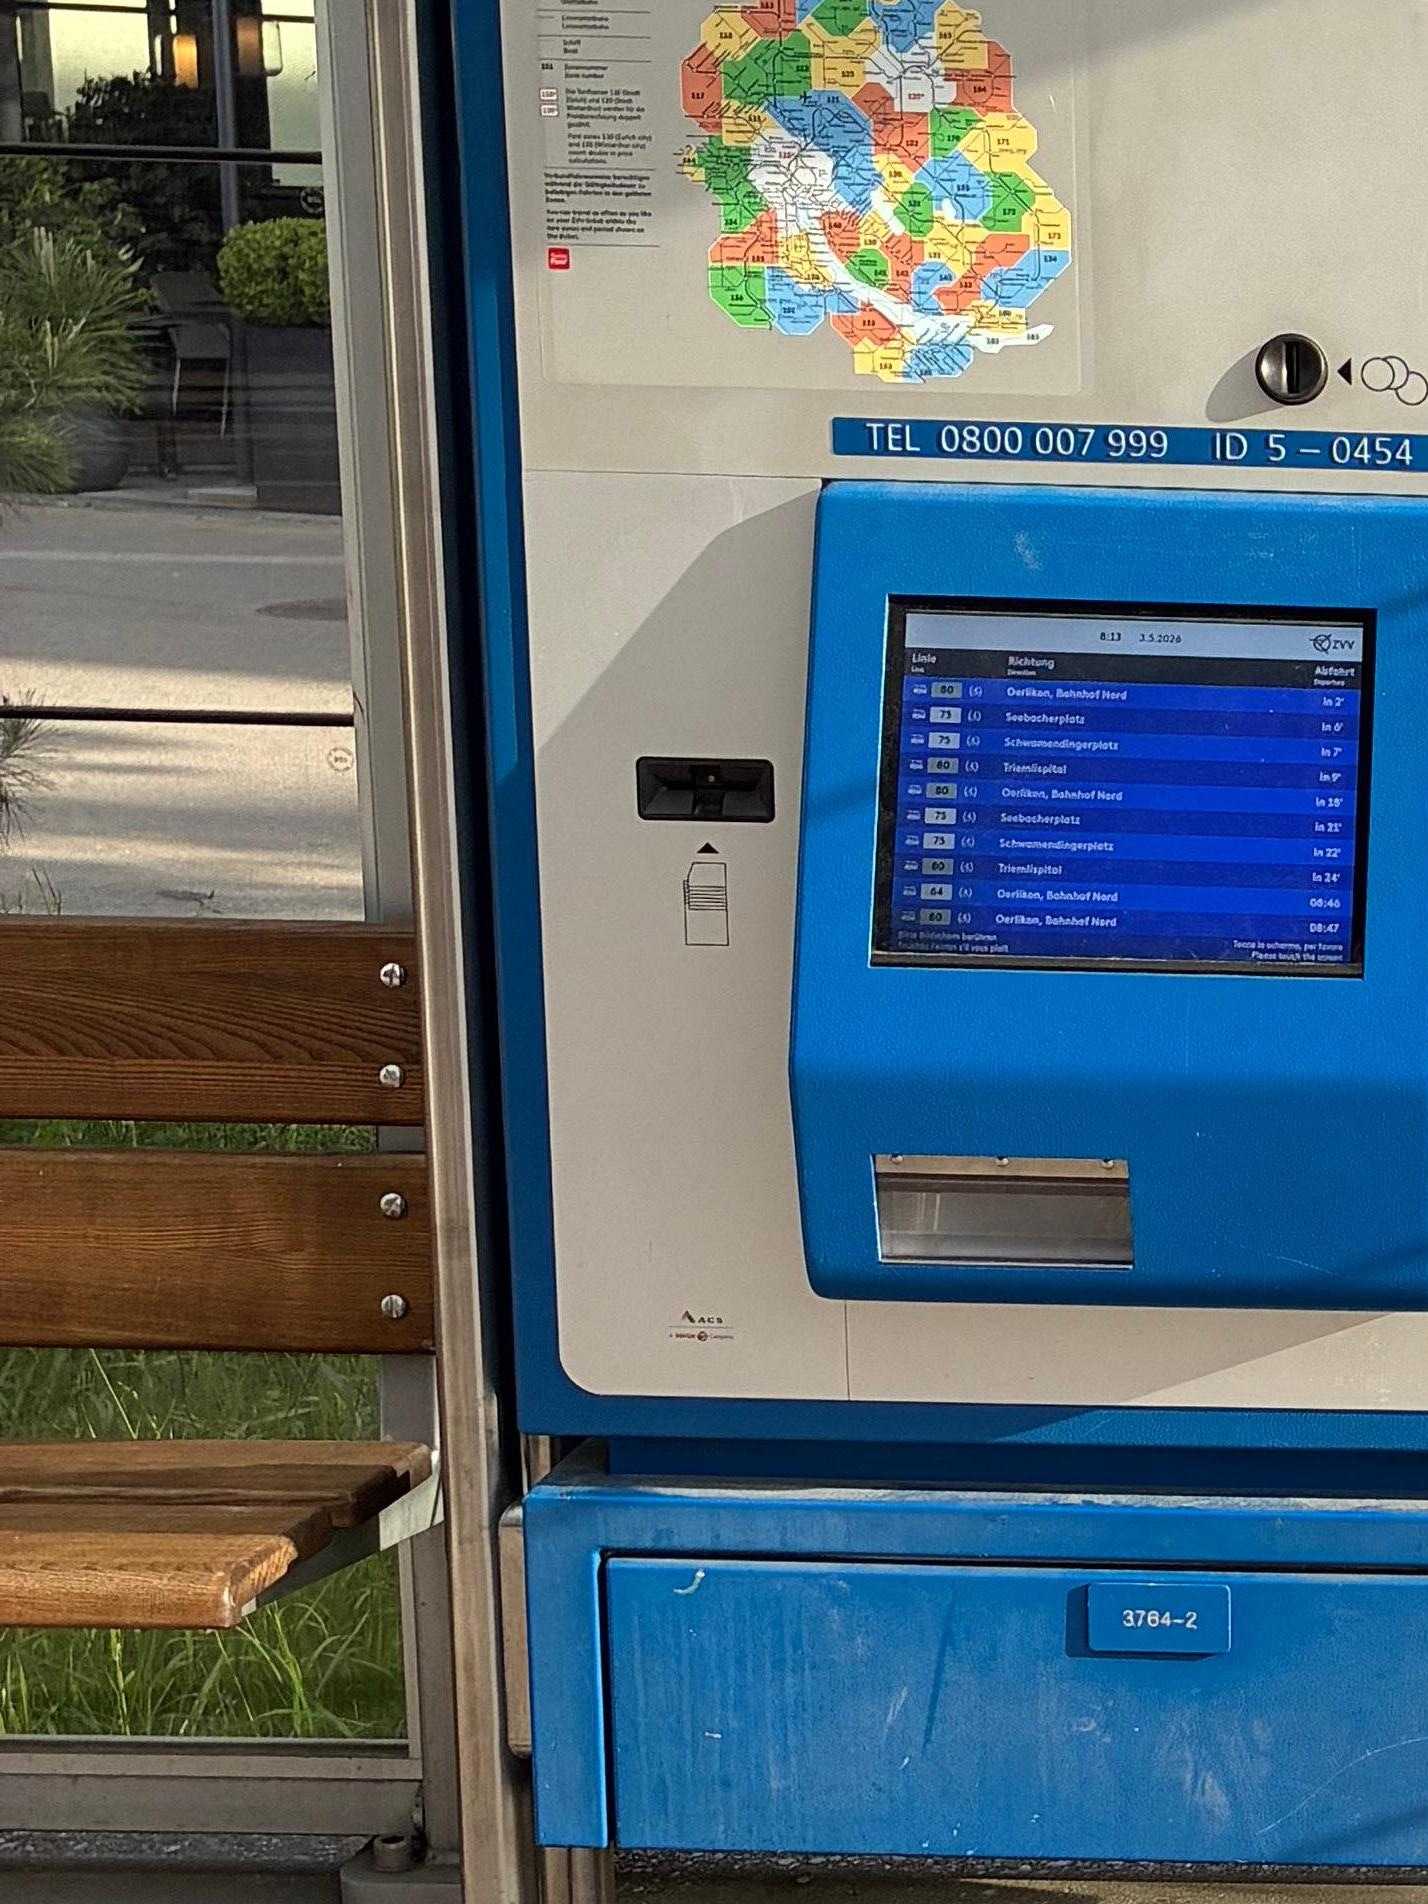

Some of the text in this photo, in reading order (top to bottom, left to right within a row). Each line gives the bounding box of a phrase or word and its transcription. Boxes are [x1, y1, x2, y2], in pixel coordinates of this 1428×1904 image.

[866, 422, 920, 453] TEL
[941, 424, 1023, 455] 0800
[1035, 427, 1094, 457] 007
[1107, 429, 1168, 459] 999
[1214, 433, 1248, 461] ID
[1332, 436, 1414, 465] 0454
[1333, 639, 1355, 650] ZVV
[912, 653, 1355, 677] Linie Richtung Abfahrt
[1007, 687, 1053, 699] Oerlikon,
[1055, 688, 1100, 699] Bahnhof
[1102, 689, 1128, 700] Nord
[1005, 712, 1086, 725] Seebacherplatz
[1004, 737, 1119, 751] Schwamendingerplatz
[1003, 762, 1067, 775] Triemlispital
[1001, 787, 1049, 801] Oerlikon,
[1051, 789, 1096, 800] Bahnhof
[1097, 789, 1123, 801] Nord
[1000, 813, 1081, 826] Seebacherplatz
[999, 838, 1114, 853] Schwamendingerplatz
[998, 863, 1062, 876] Triemlispital
[997, 888, 1044, 902] Oerlikon,
[1046, 890, 1091, 902] Bahnhof
[1092, 891, 1119, 903] Nord
[995, 913, 1043, 927] Oerlikon,
[1045, 915, 1090, 927] Bahnhof
[1091, 916, 1117, 928] Nord
[1122, 1609, 1198, 1630] 3764-2
